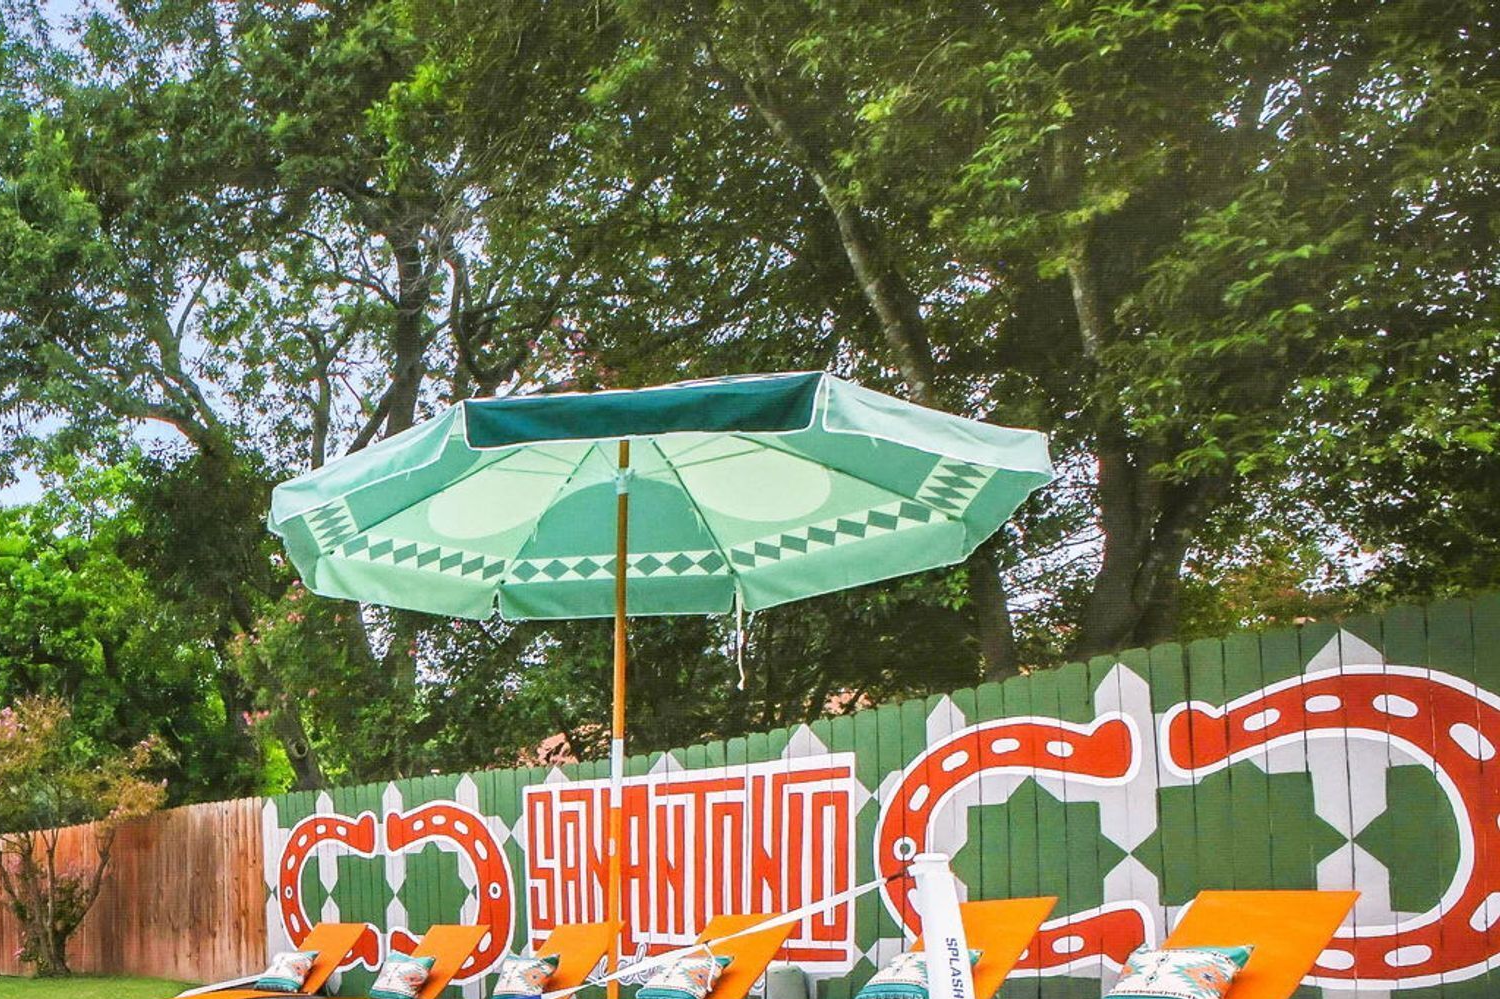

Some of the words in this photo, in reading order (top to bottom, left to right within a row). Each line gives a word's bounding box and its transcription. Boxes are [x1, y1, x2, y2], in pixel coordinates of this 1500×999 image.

[527, 787, 620, 951] SAN
[619, 766, 850, 961] ANTONIO
[946, 937, 965, 999] SPLASH
